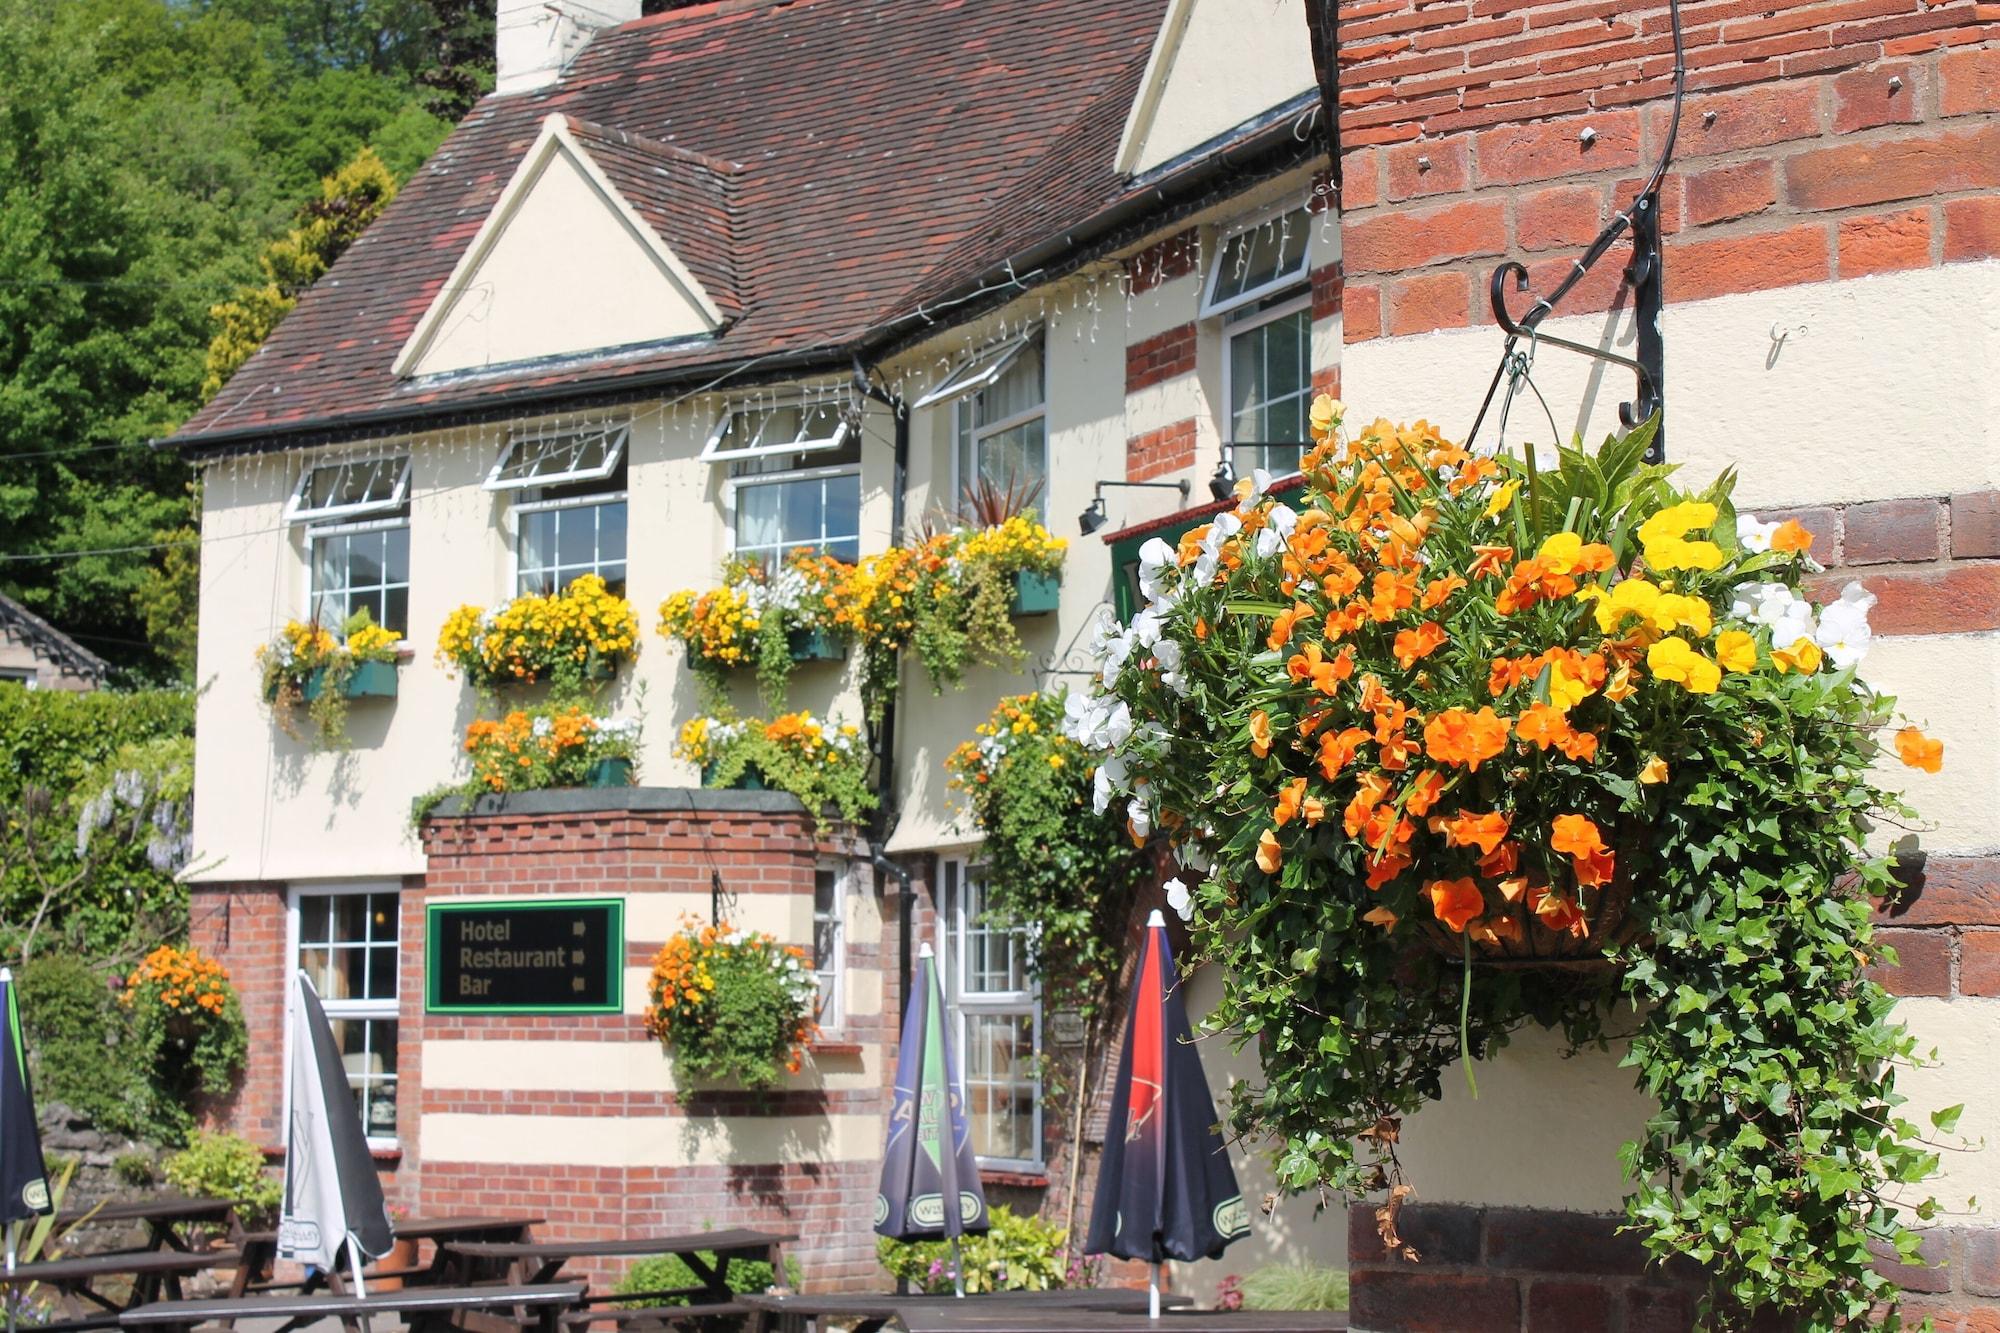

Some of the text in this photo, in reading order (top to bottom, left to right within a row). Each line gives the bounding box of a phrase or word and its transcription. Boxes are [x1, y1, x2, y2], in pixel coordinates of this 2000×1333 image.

[461, 919, 511, 941] Hotel
[460, 946, 566, 968] Restaurant
[460, 974, 492, 995] Bar
